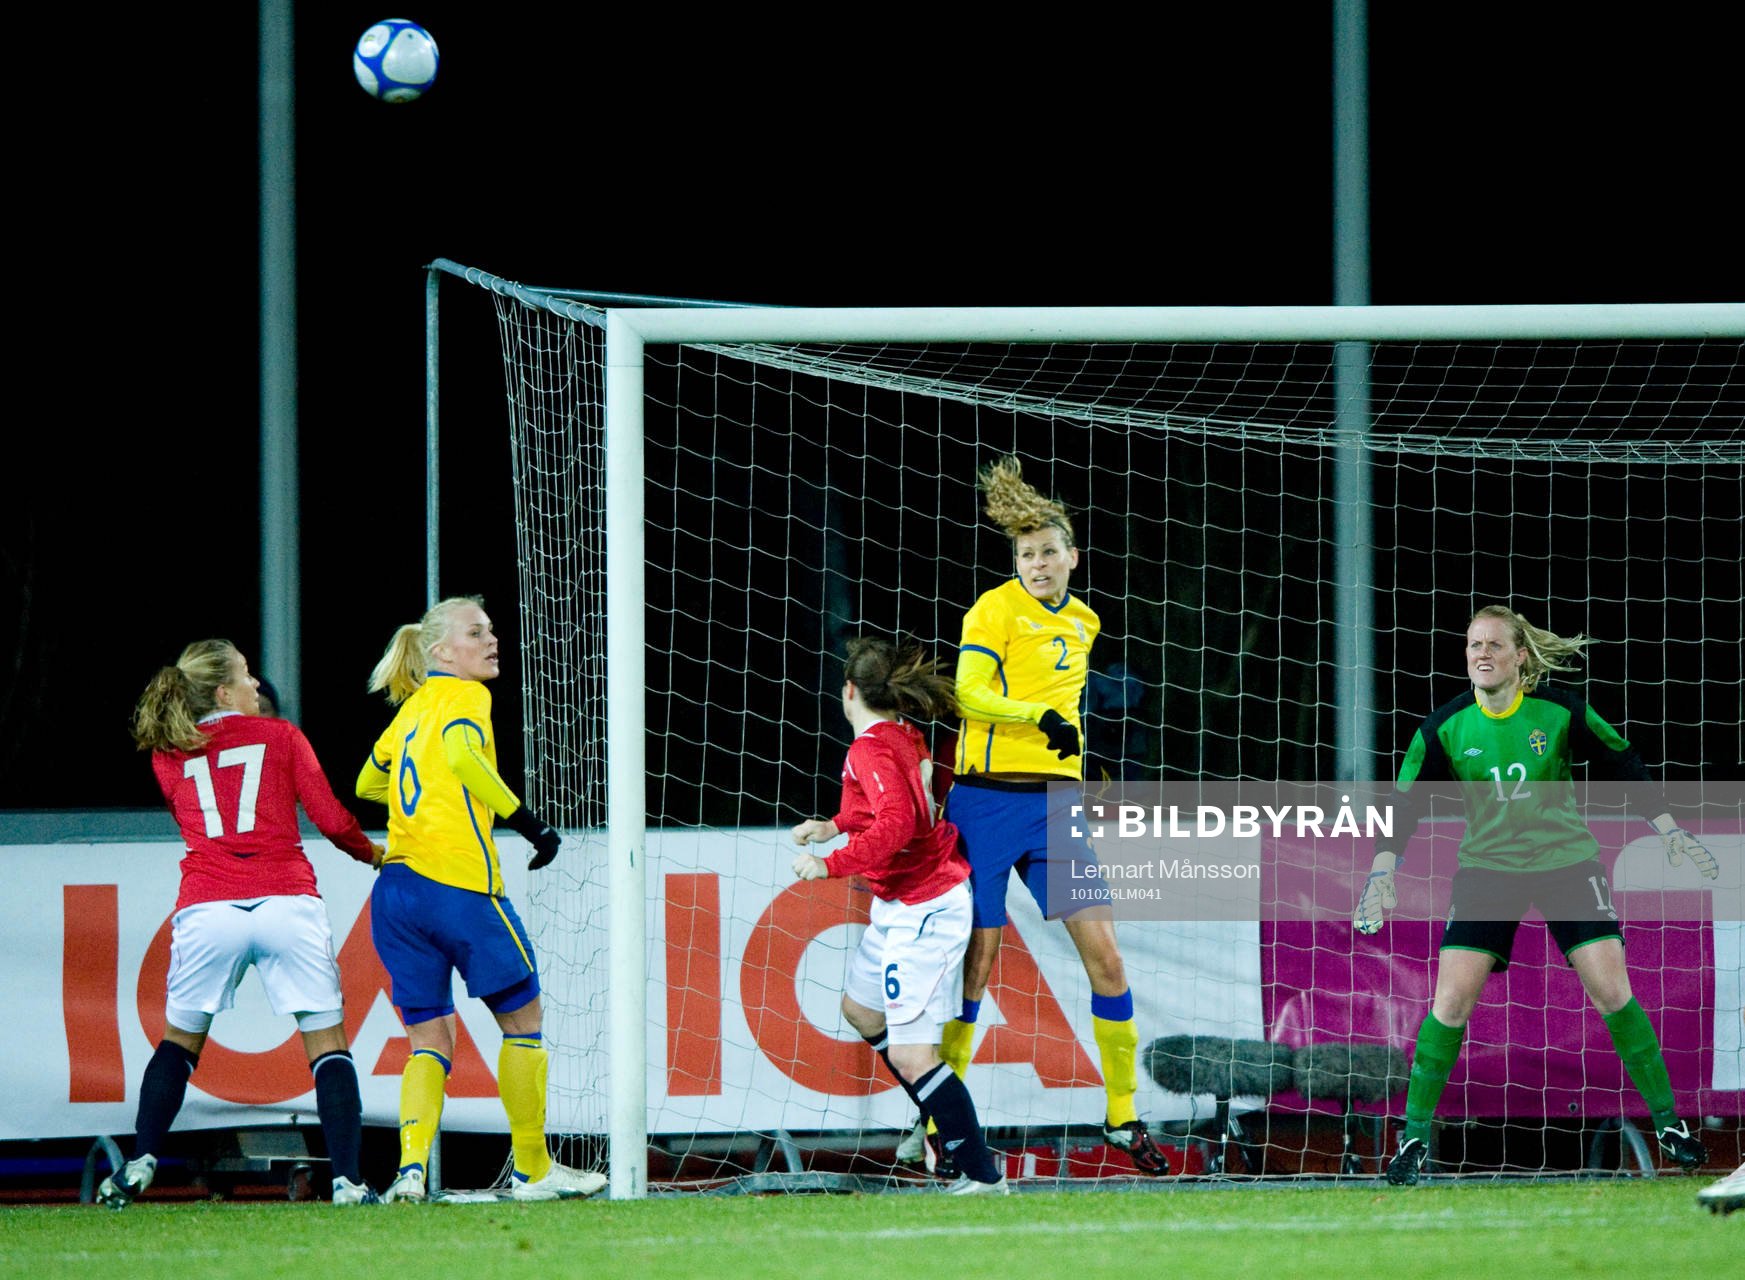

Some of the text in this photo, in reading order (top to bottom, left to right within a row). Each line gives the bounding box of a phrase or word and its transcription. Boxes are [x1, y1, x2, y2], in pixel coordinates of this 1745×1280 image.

[1052, 635, 1071, 671] 2
[400, 724, 422, 817] 6
[1489, 762, 1532, 802] 12
[183, 743, 267, 839] 17
[885, 963, 900, 1000] 6
